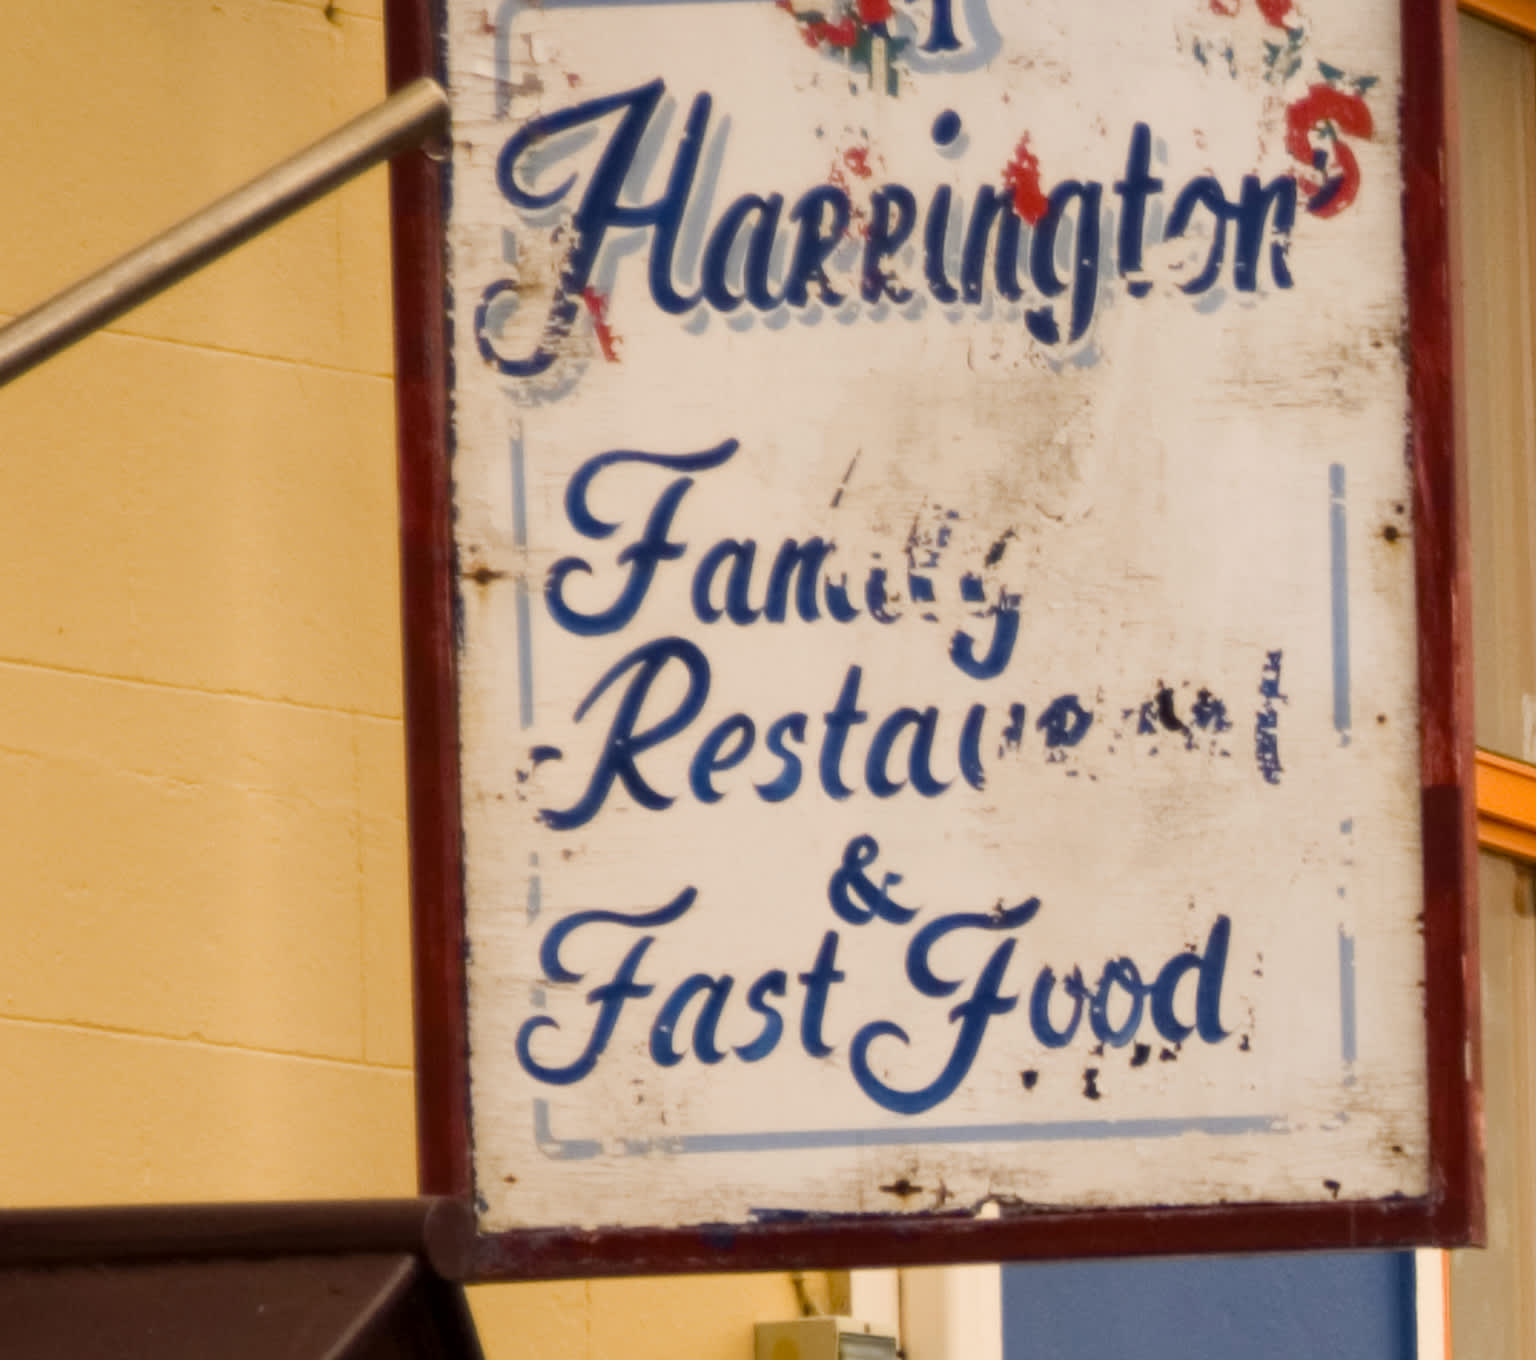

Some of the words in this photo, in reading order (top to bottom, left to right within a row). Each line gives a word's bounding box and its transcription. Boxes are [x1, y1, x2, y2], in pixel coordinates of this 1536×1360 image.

[531, 636, 1286, 831] Restaut
[827, 833, 920, 926] &
[515, 886, 846, 1087] Fast
[849, 896, 1232, 1116] Food
